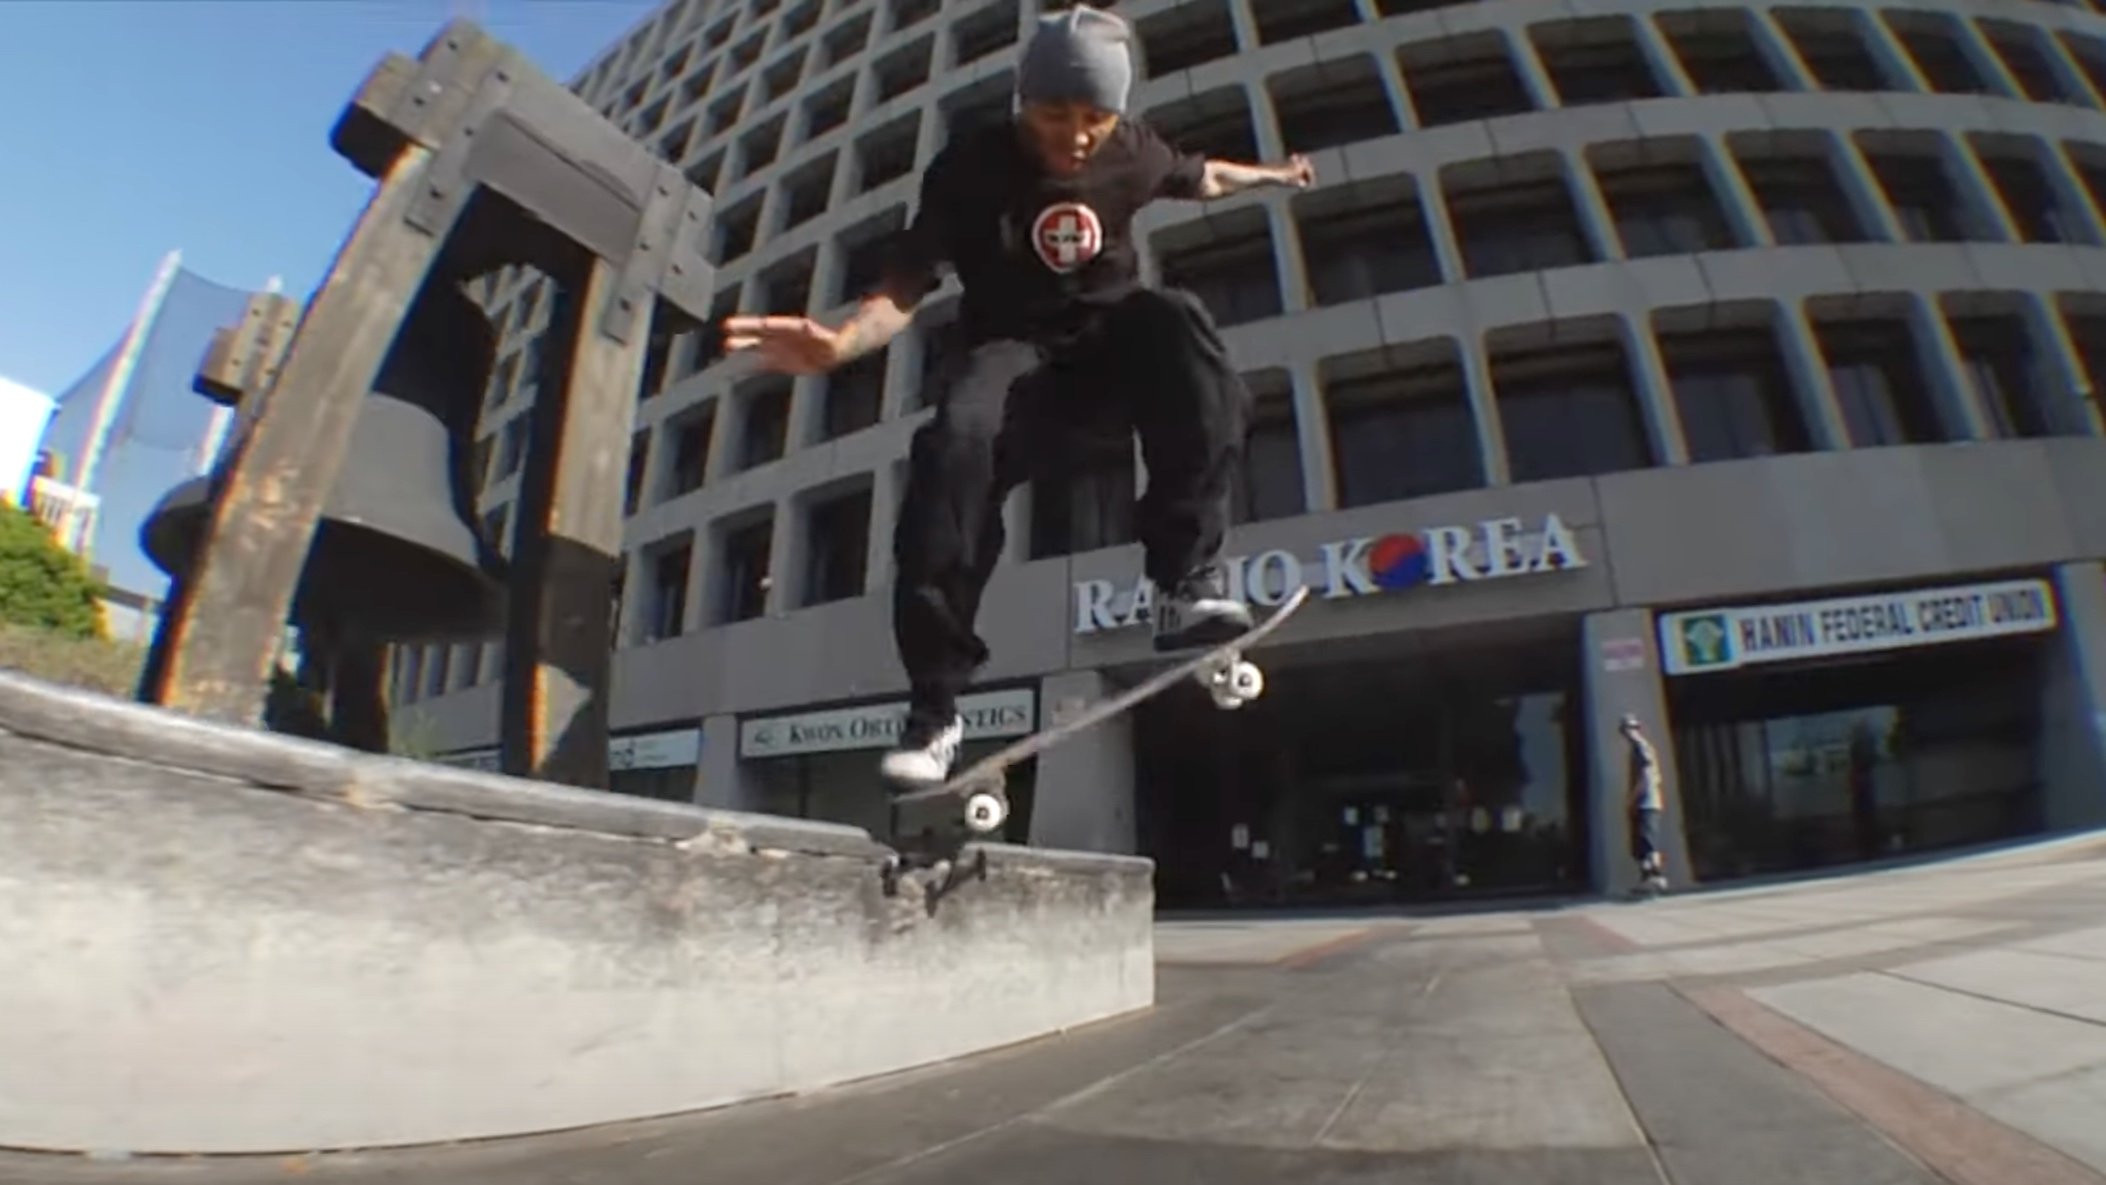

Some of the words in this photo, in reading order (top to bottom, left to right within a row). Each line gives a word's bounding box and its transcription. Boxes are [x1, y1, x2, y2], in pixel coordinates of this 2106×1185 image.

[1073, 550, 1301, 634] RAIO
[1321, 513, 1588, 598] KOREA
[1739, 613, 1815, 653] HANIN
[1820, 602, 1913, 643] FEDERAL
[1917, 593, 1982, 632] CREDIT
[1987, 586, 2045, 624] UNION
